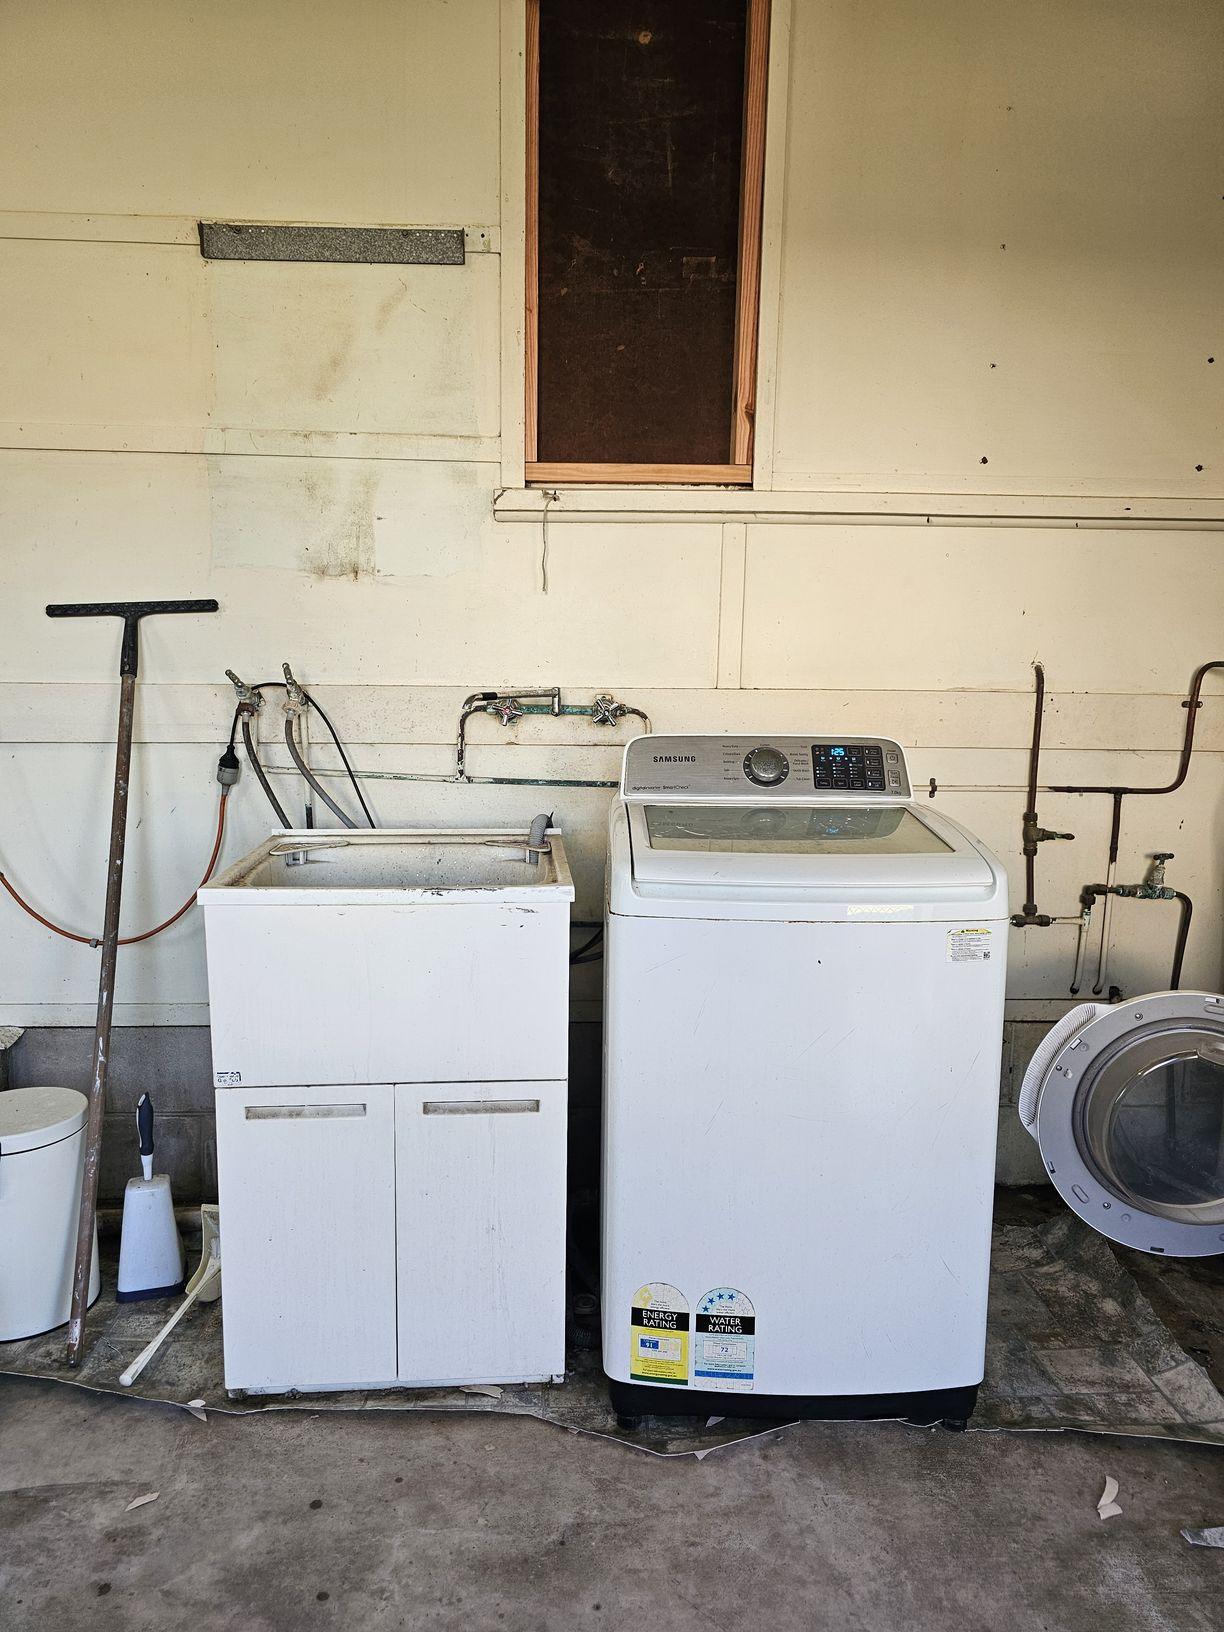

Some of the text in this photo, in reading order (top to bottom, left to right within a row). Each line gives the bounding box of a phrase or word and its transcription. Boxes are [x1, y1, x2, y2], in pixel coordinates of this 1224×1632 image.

[653, 755, 696, 763] SAMSUNG
[642, 1310, 678, 1321] ENERGY
[643, 1318, 677, 1329] RATING
[709, 1316, 741, 1326] WATER
[708, 1324, 743, 1334] RATING
